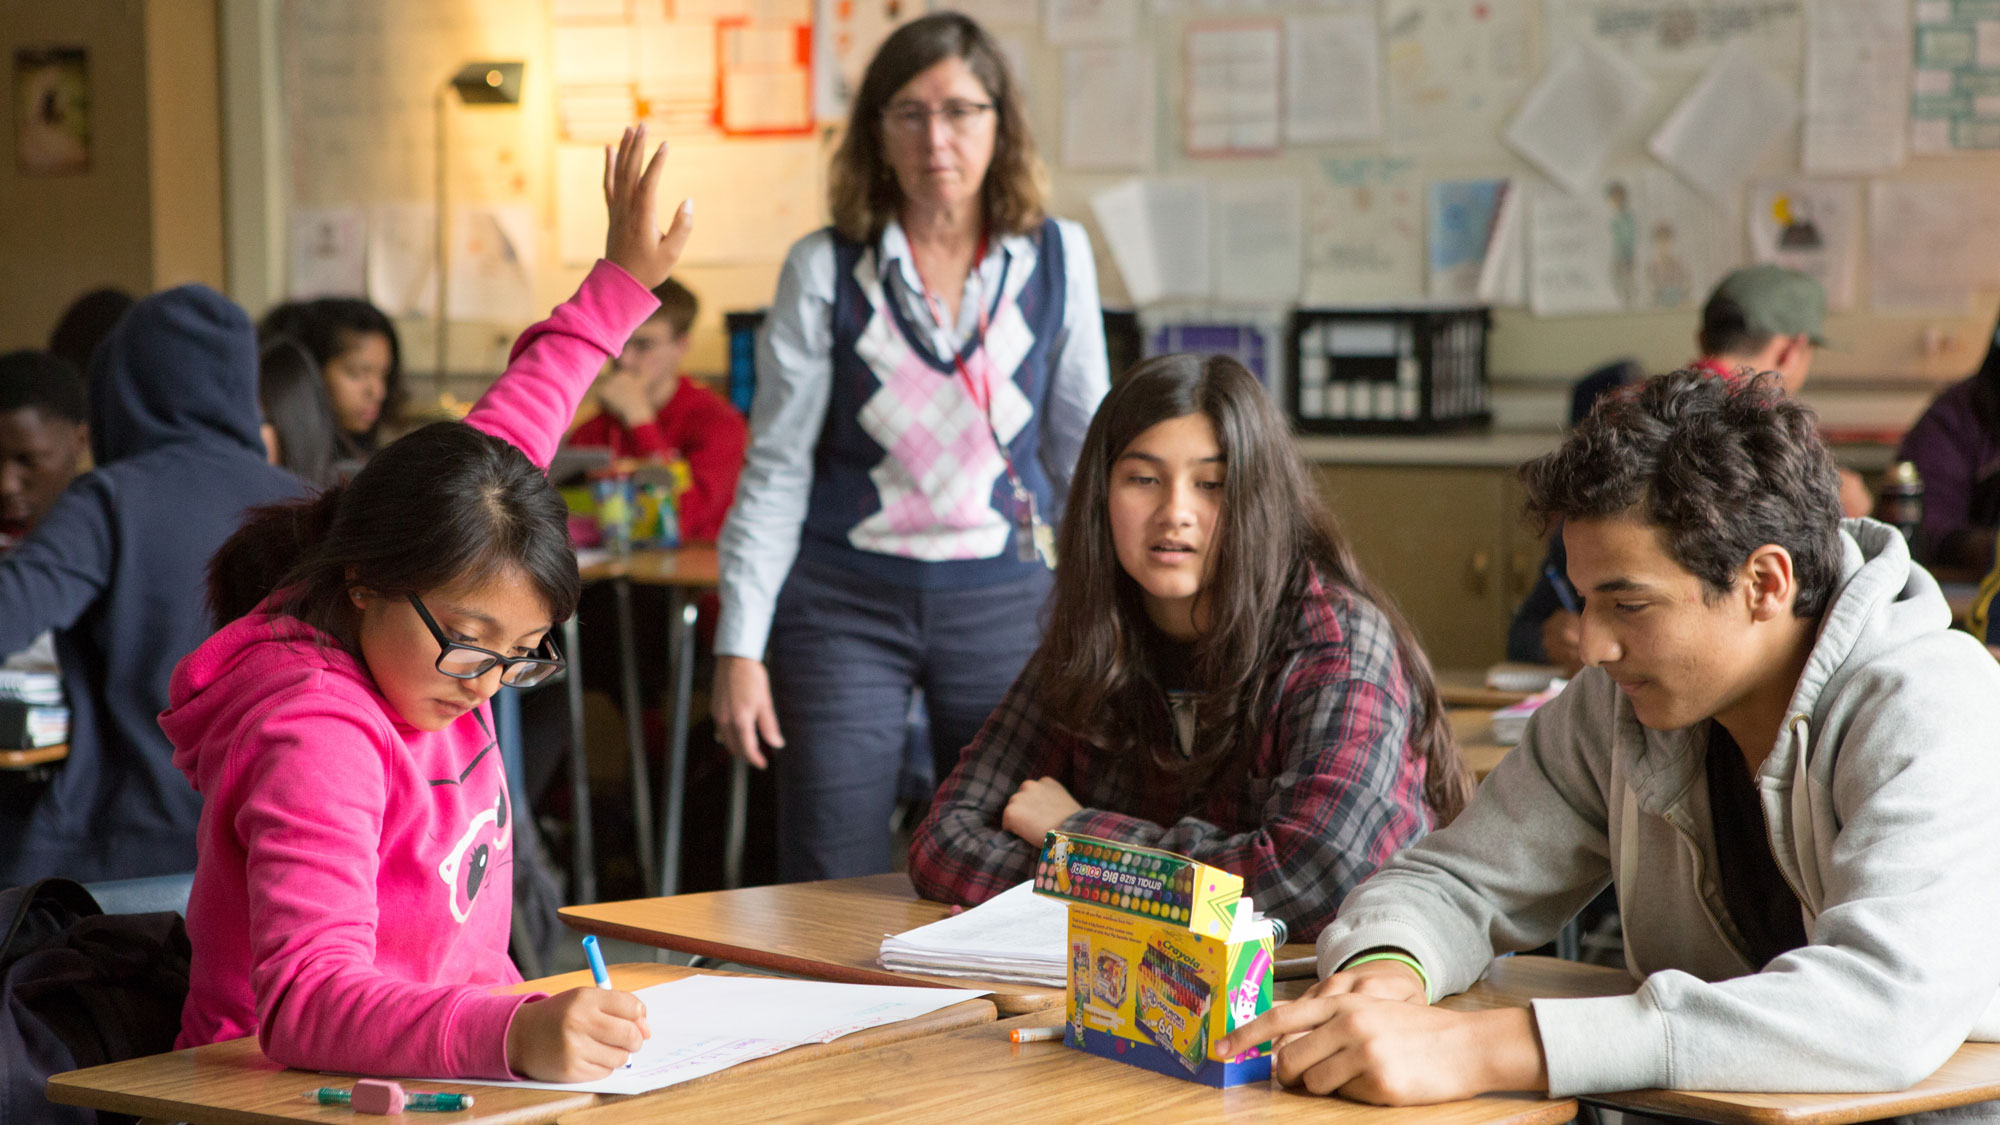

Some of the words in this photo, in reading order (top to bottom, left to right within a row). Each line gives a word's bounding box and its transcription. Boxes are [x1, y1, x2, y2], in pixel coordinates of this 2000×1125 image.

[1102, 870, 1119, 884] BIG
[1120, 873, 1136, 885] size
[1138, 876, 1162, 890] small
[1162, 940, 1200, 969] Crayola
[1158, 1018, 1174, 1040] 64
